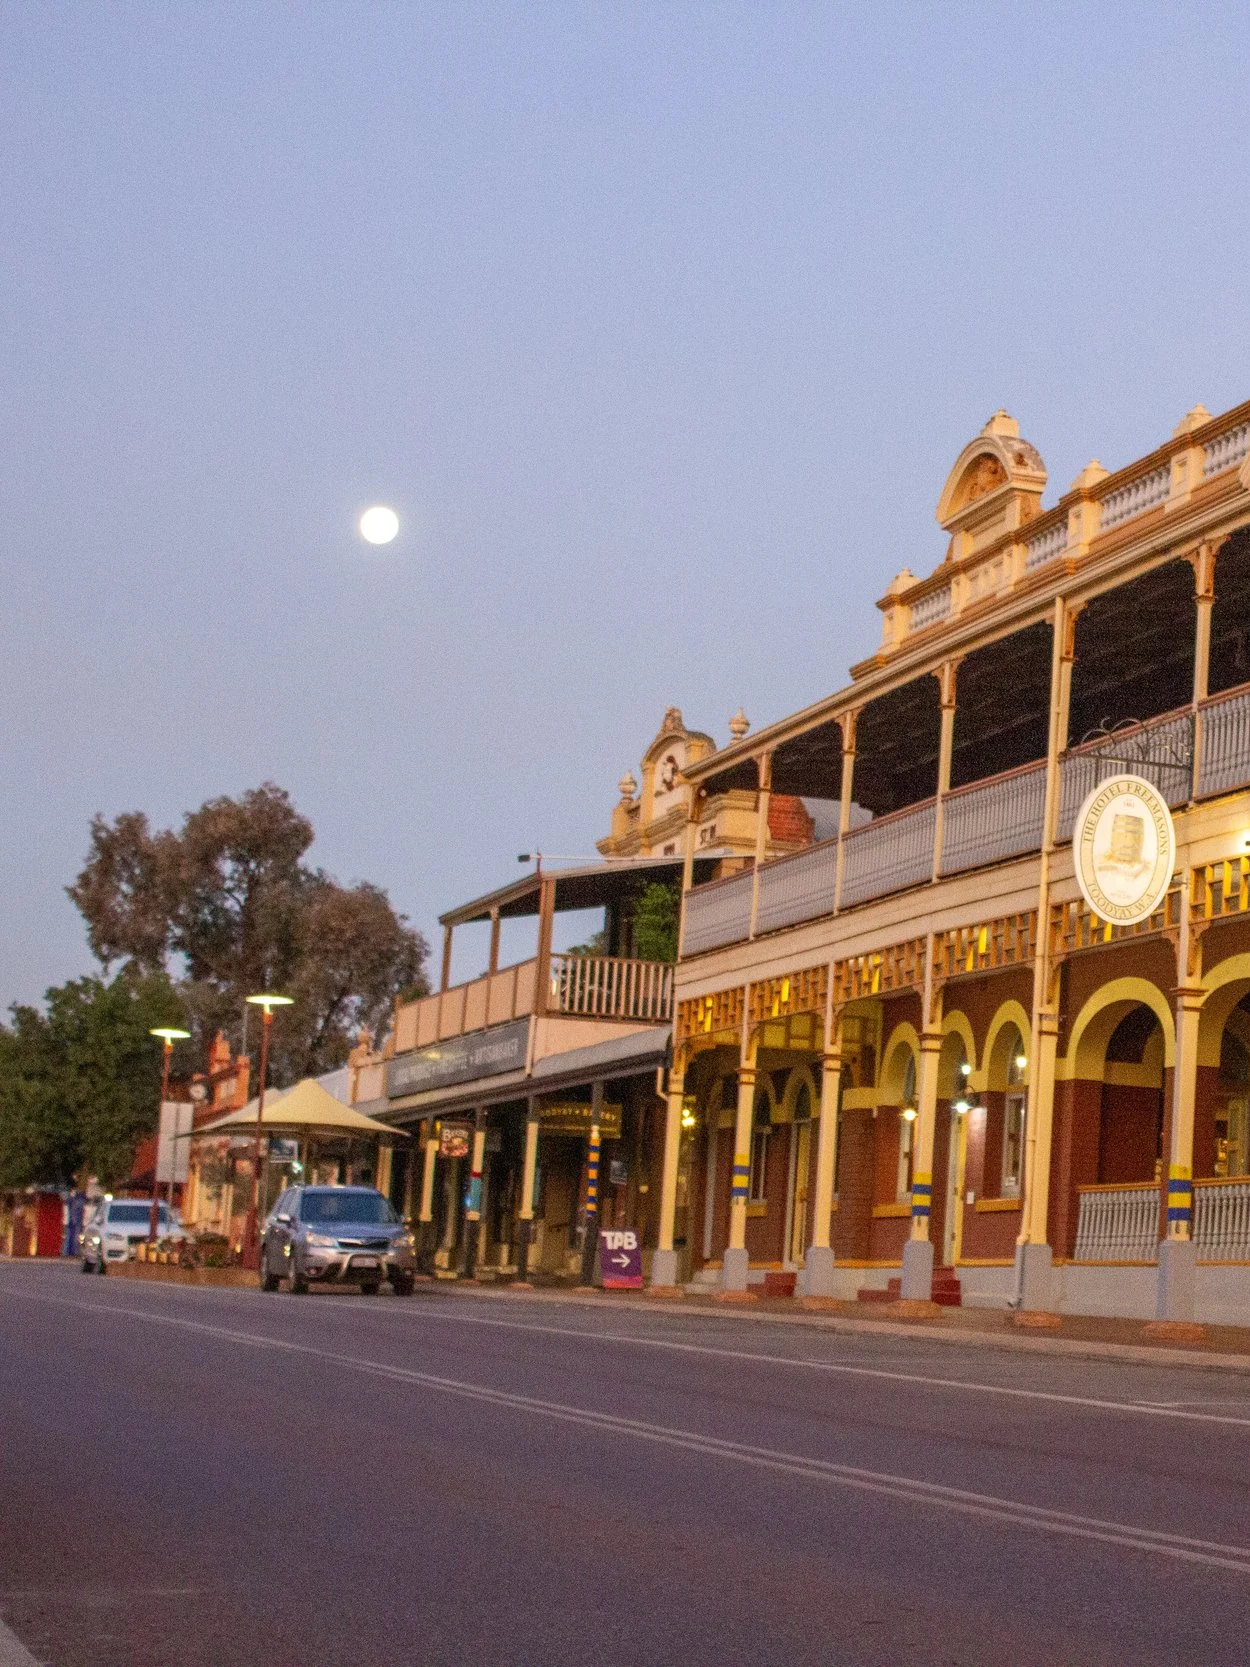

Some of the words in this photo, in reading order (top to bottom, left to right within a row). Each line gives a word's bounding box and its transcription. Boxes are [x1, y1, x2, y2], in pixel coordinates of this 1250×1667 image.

[1083, 818, 1096, 842] THE
[1091, 784, 1121, 817] HOTEL
[1126, 783, 1168, 855] FREEMASONS
[1087, 882, 1132, 918] TOODYAY
[601, 1231, 638, 1250] TAB
